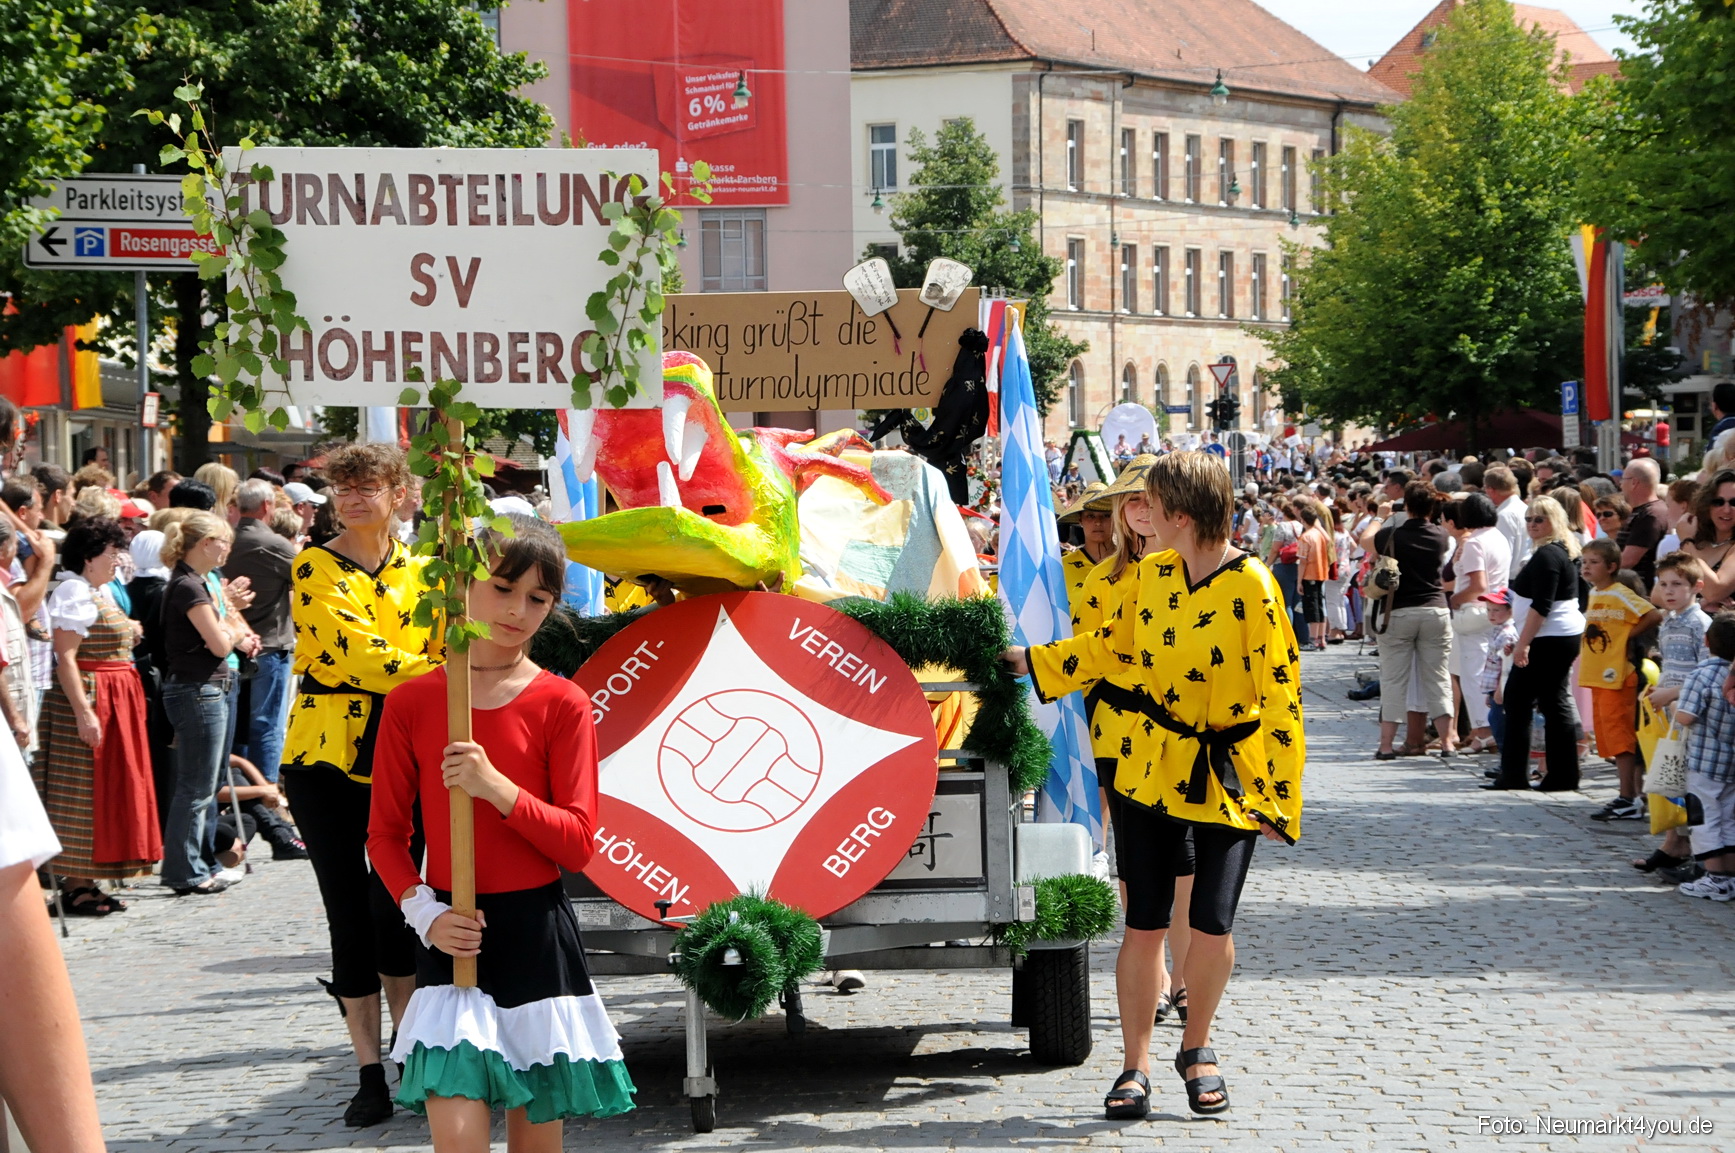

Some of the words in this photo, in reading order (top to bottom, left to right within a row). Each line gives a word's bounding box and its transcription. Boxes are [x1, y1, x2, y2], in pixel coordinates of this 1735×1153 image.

[685, 75, 707, 84] Unser
[685, 84, 725, 94] Schmankerl
[689, 97, 702, 117] 6
[703, 94, 726, 114] %
[687, 113, 749, 131] Getränkemarke
[689, 163, 735, 172] Skasse
[689, 175, 777, 185] Nmarkt-Parsberg
[689, 186, 777, 194] .sarkasse-neumarkt.de
[66, 187, 215, 217] Parkleitsyst
[120, 231, 217, 257] Rosengasse
[662, 304, 730, 356] eking
[743, 300, 824, 355] grüßt
[838, 300, 878, 346] die
[713, 351, 932, 411] turnolympiade
[788, 617, 888, 695] VEREIN
[821, 806, 897, 879] BERG
[593, 826, 692, 906] HÖHEN-
